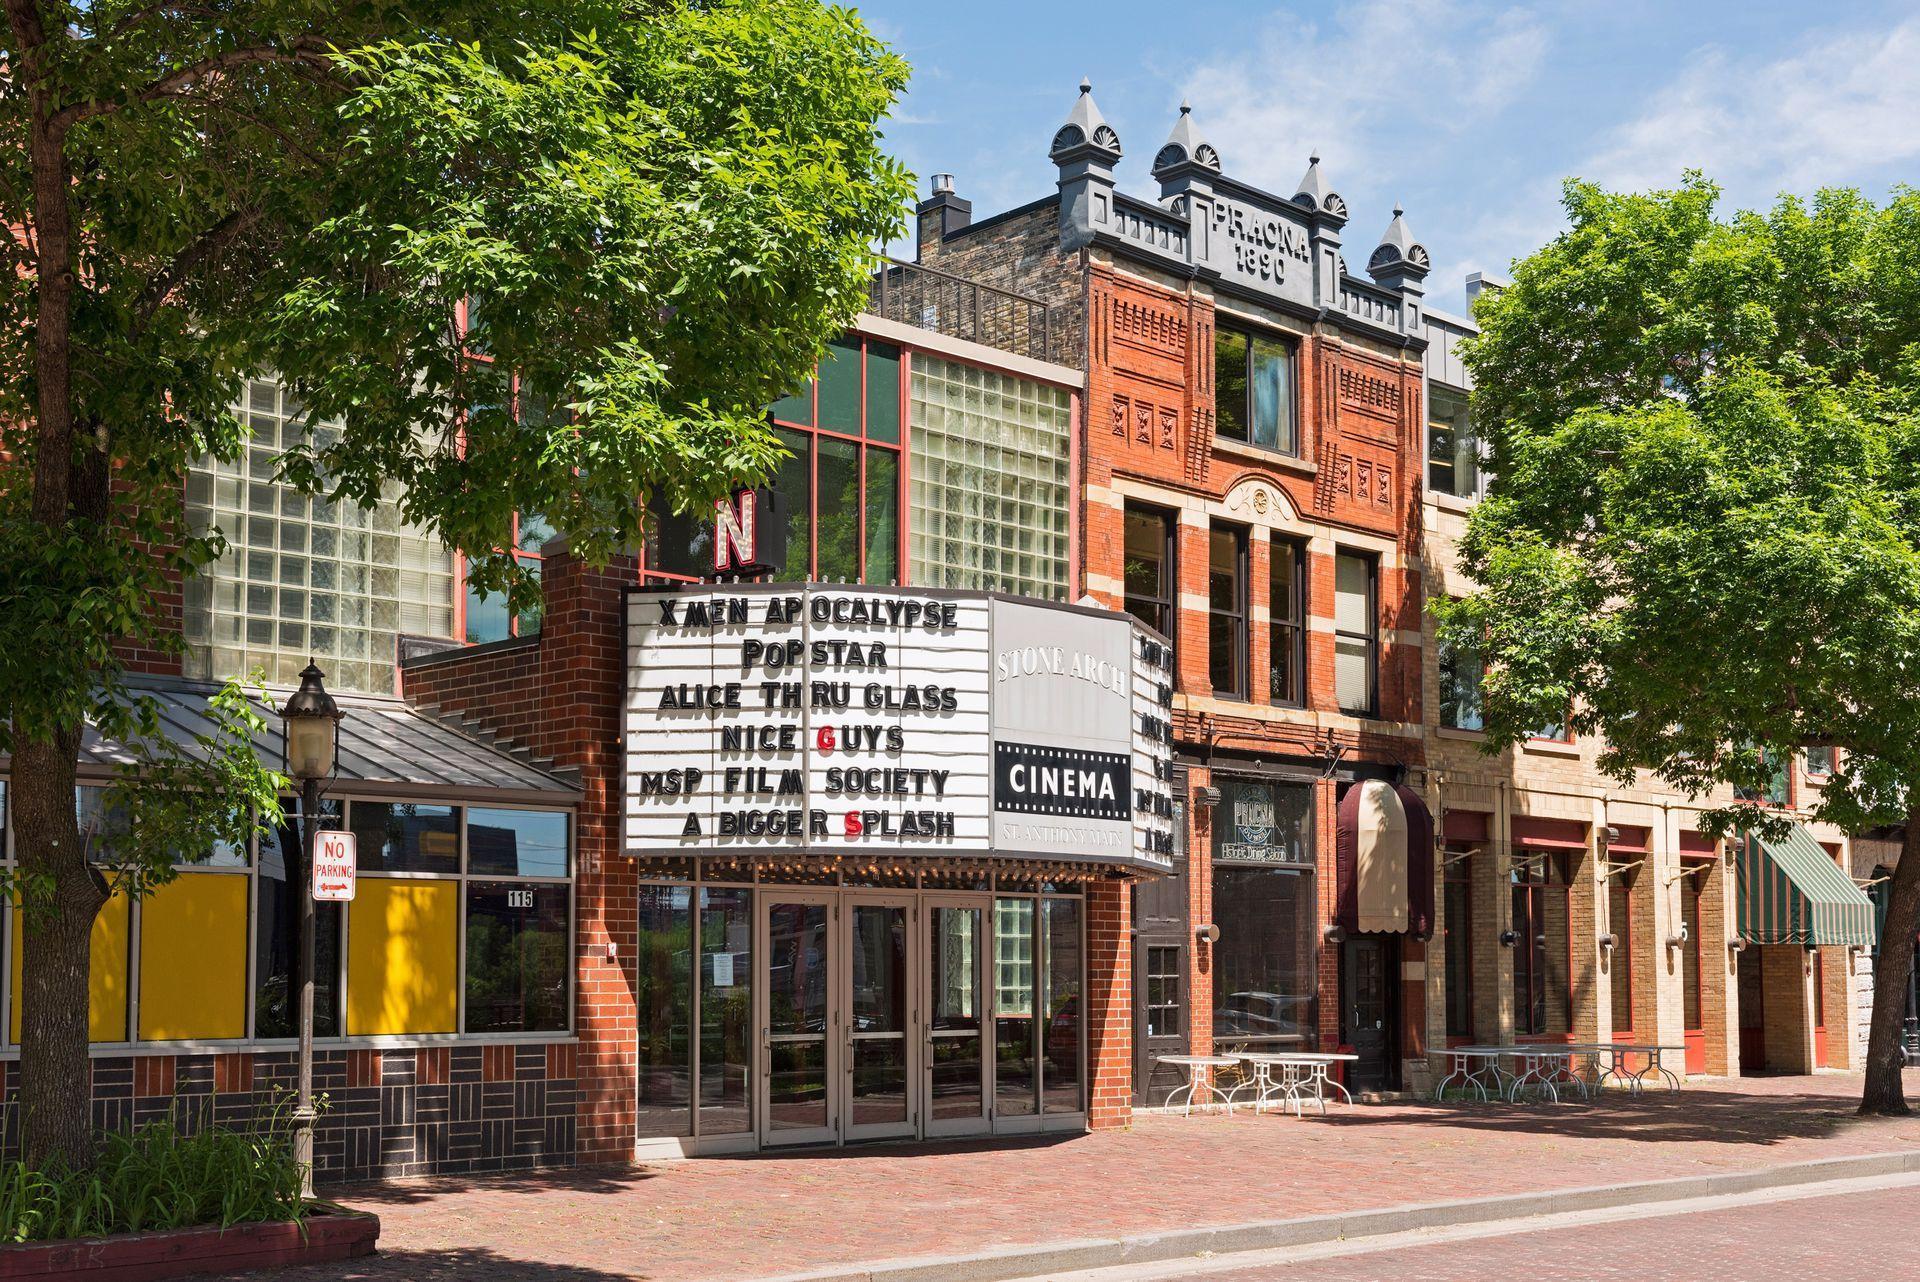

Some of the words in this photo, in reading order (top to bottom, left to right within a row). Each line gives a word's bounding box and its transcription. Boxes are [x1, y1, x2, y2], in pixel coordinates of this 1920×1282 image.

[1212, 202, 1309, 264] PRACNA
[1235, 243, 1285, 286] 1890
[765, 596, 957, 628] APOCALYPSE
[997, 646, 1065, 683] STONE
[1070, 651, 1127, 699] ARCH
[658, 683, 741, 710] ALICE
[761, 681, 850, 709] THRU
[863, 683, 957, 712] GLASS
[722, 725, 796, 751] NICE
[816, 725, 904, 752] GUYS
[640, 768, 703, 796] MSP
[725, 767, 804, 795] FILM
[825, 767, 949, 795] SOCIETY
[1009, 764, 1115, 800] CINEMA
[682, 812, 702, 836] A
[719, 809, 828, 837] BIGGER
[845, 810, 955, 838] SPLASH
[1025, 825, 1087, 845] ANTHONY
[1090, 829, 1123, 847] MAIN
[325, 842, 345, 858] NO
[580, 851, 601, 875] 115
[316, 865, 352, 878] PARKING
[509, 891, 532, 906] 115
